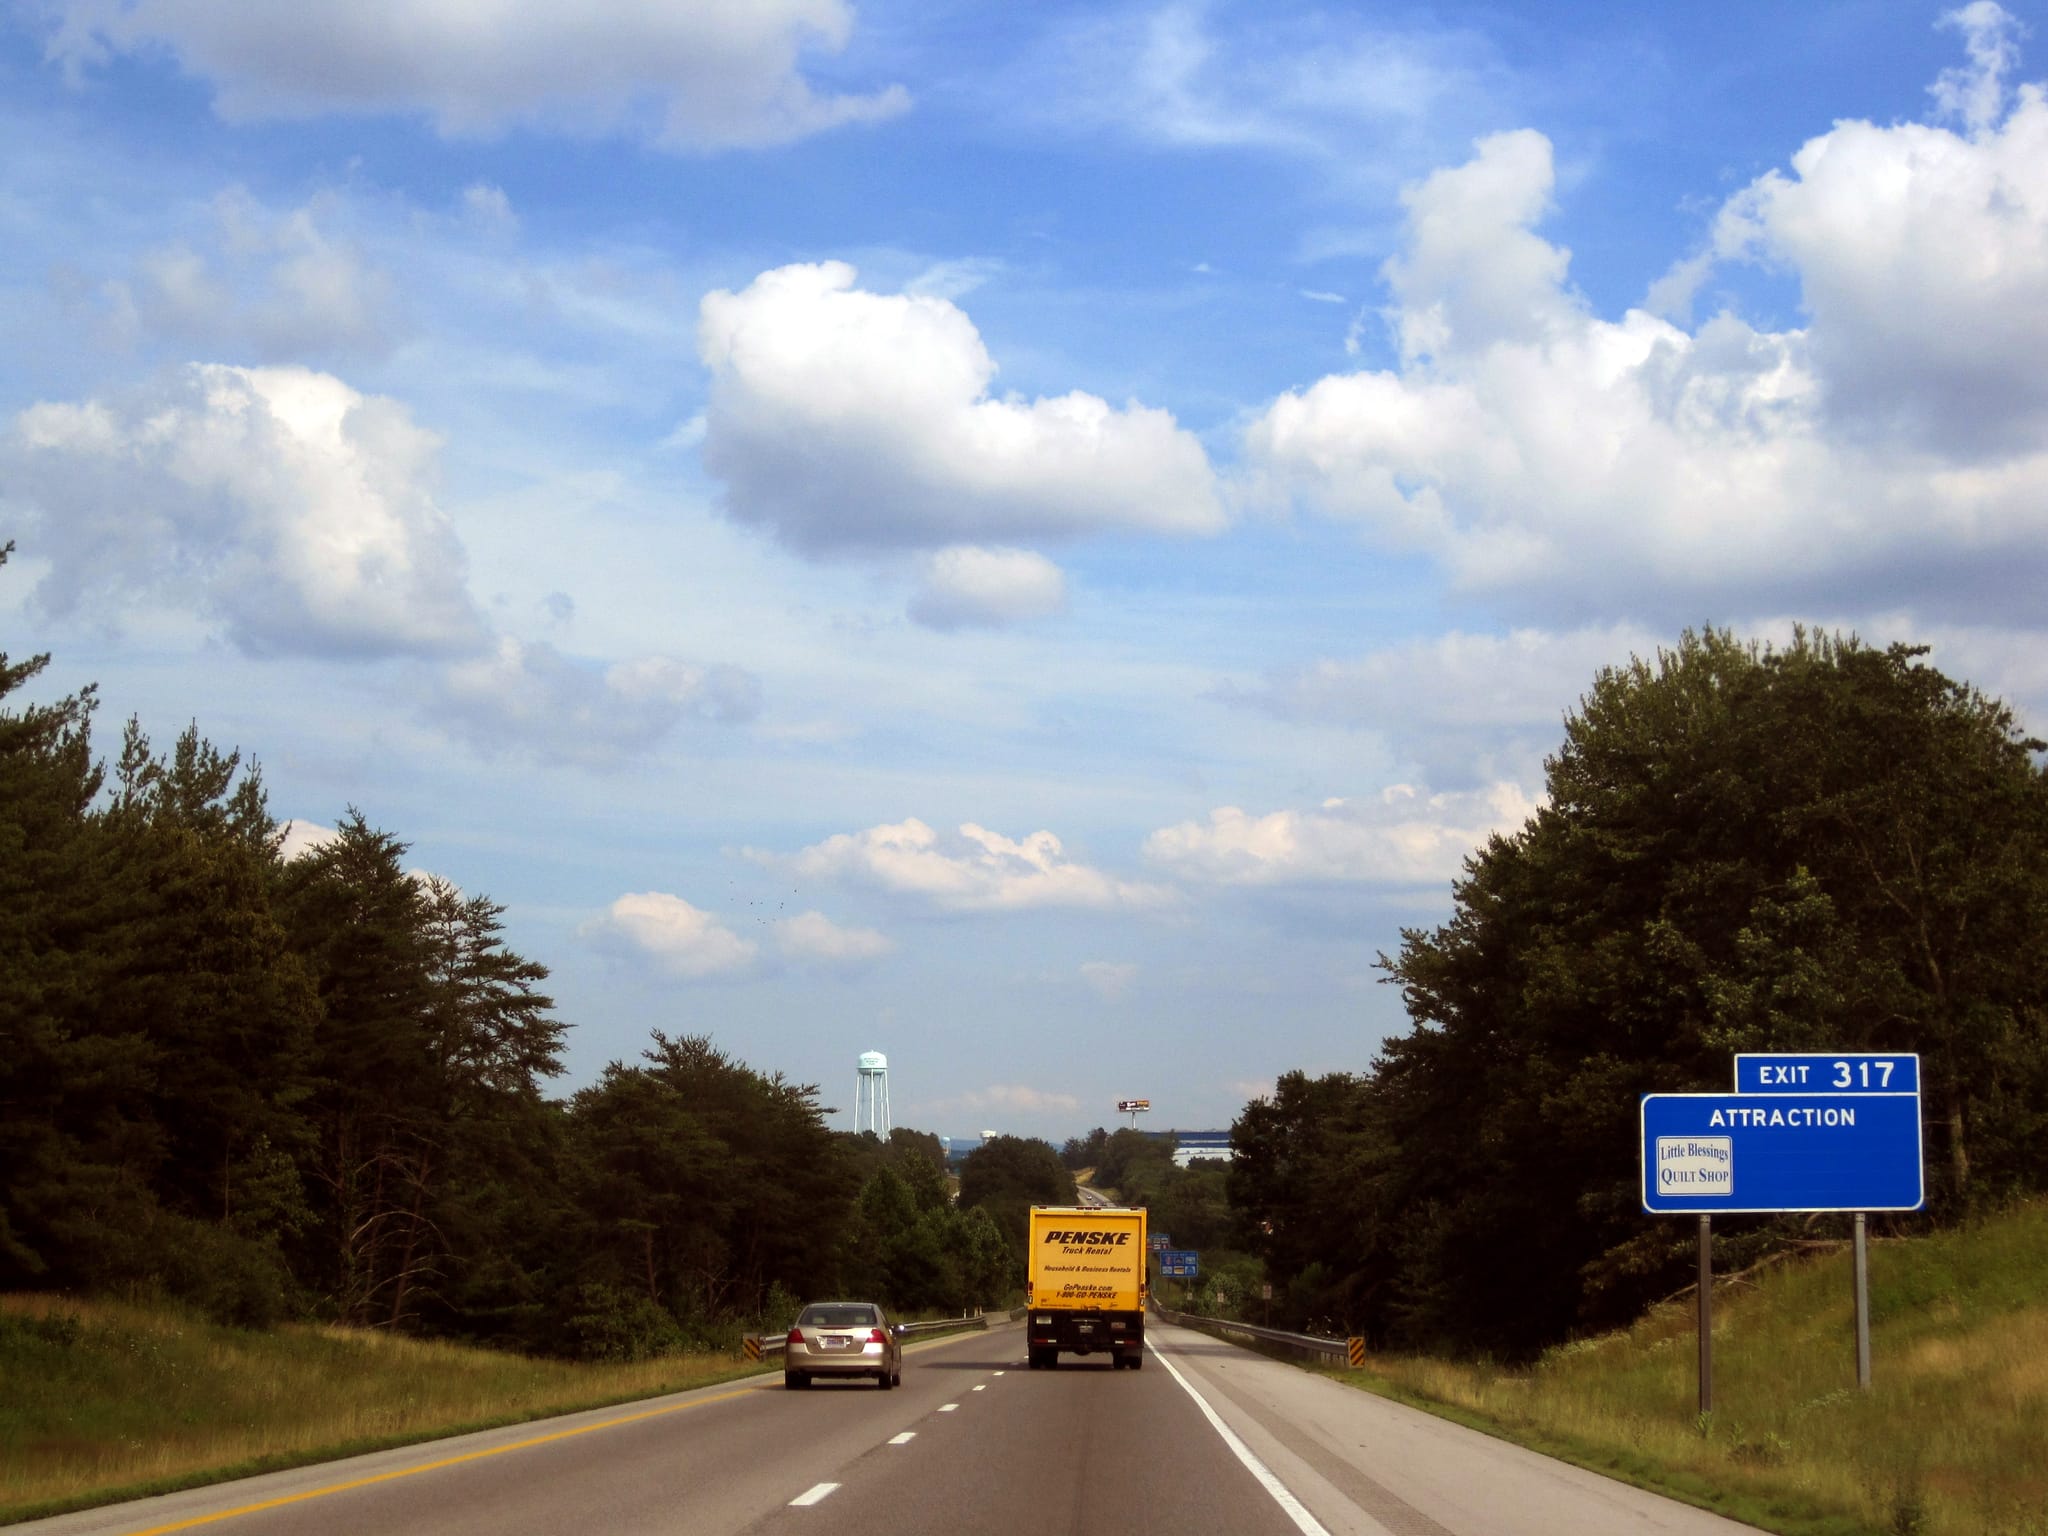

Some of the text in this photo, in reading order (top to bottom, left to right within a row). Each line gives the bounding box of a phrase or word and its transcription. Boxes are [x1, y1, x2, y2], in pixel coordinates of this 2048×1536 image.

[1760, 1061, 1895, 1088] EXIT 317
[1709, 1108, 1856, 1127] ATTRACTION
[1660, 1143, 1729, 1163] Little Blessings
[1661, 1168, 1729, 1185] QUILT SHOP
[1044, 1231, 1131, 1245] PENSKE
[1062, 1246, 1113, 1255] Truck Rental
[1056, 1291, 1118, 1299] 1-800-GO-PENSKE
